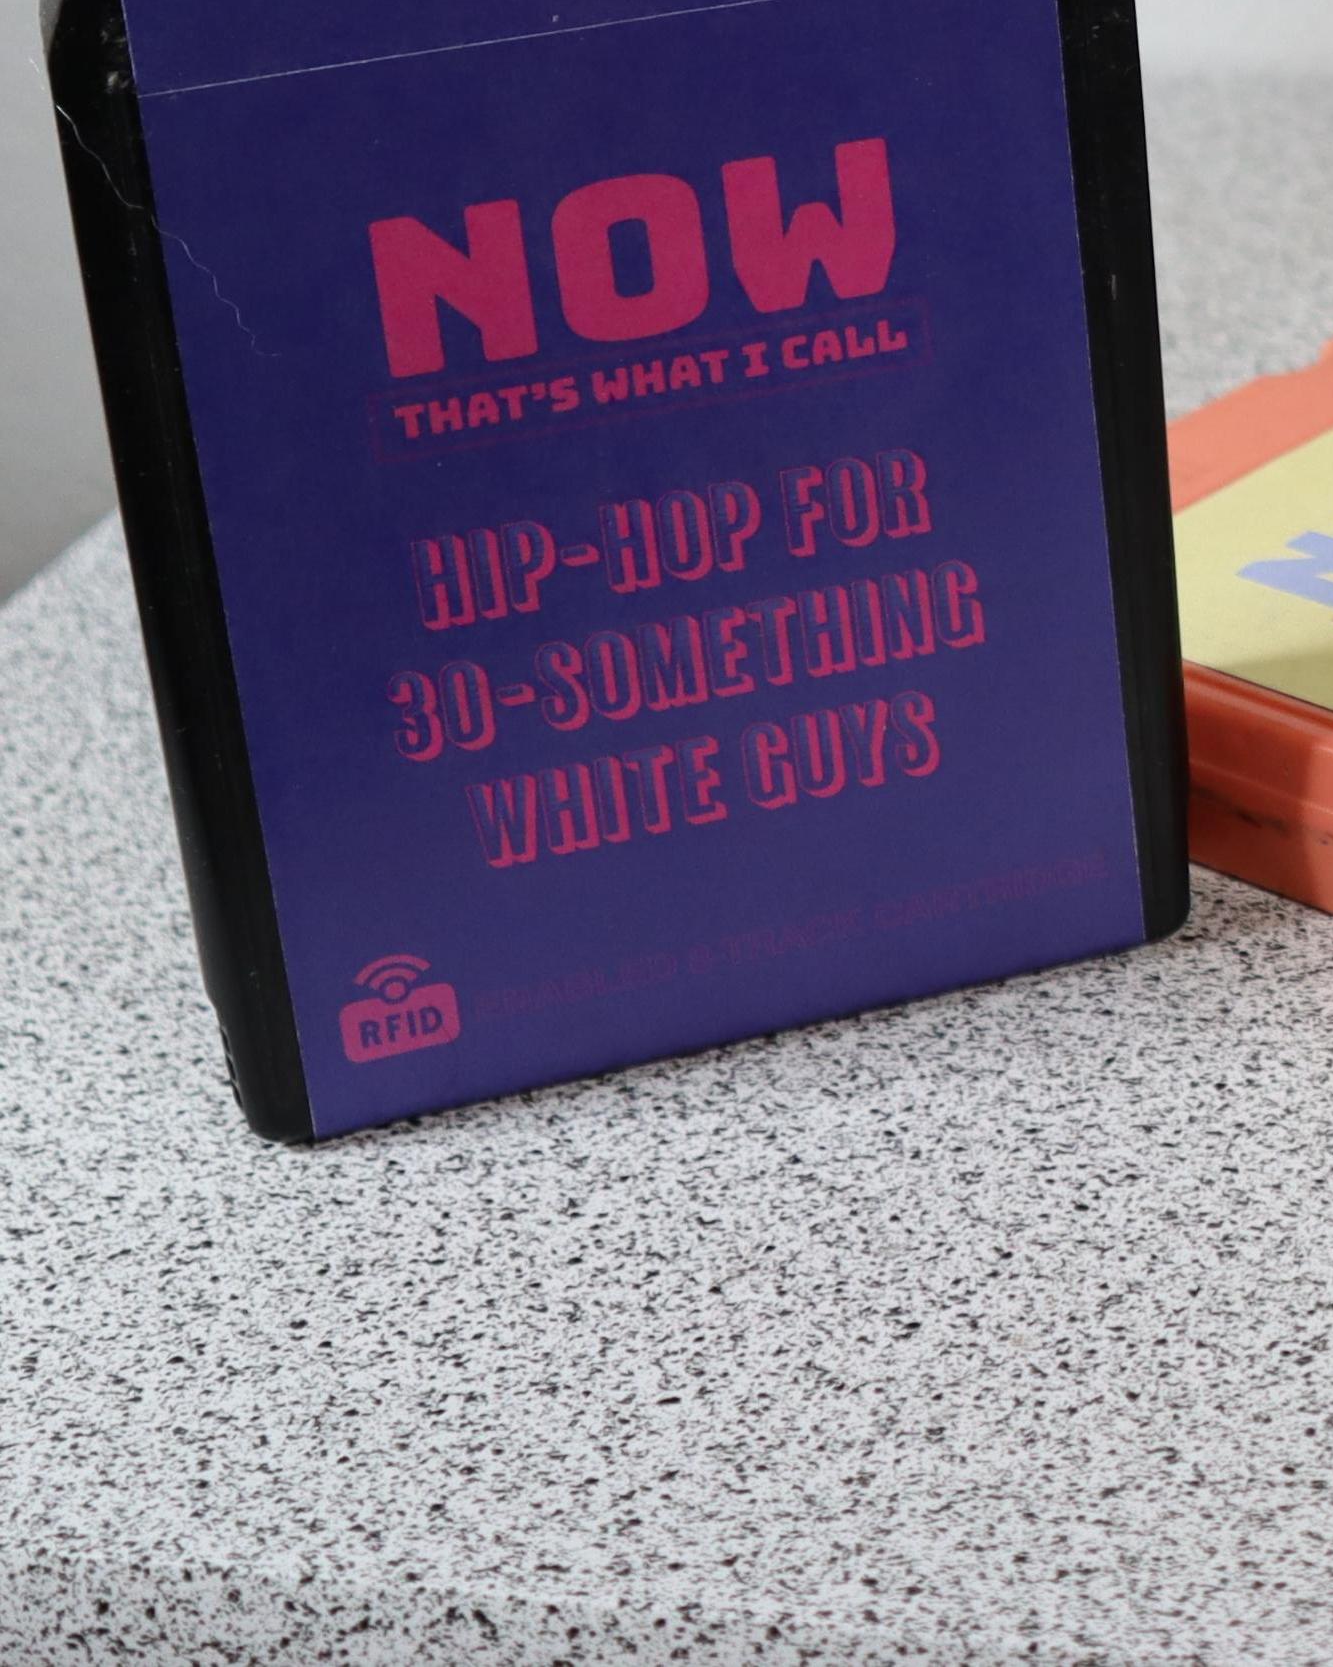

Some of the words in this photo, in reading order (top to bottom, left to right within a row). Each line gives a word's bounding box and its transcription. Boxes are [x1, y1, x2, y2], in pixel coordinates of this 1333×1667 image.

[367, 137, 899, 379] NOW
[393, 375, 581, 439] THAT'S
[591, 349, 730, 405] WHAT
[740, 342, 770, 379] I
[781, 319, 908, 372] CALL
[410, 480, 762, 631] HIP-HOP
[778, 448, 933, 558] FOR
[386, 559, 986, 764] 30-SOMETHING
[465, 734, 728, 870] WHITE
[741, 690, 941, 813] GUYS
[358, 1005, 444, 1050] RFID
